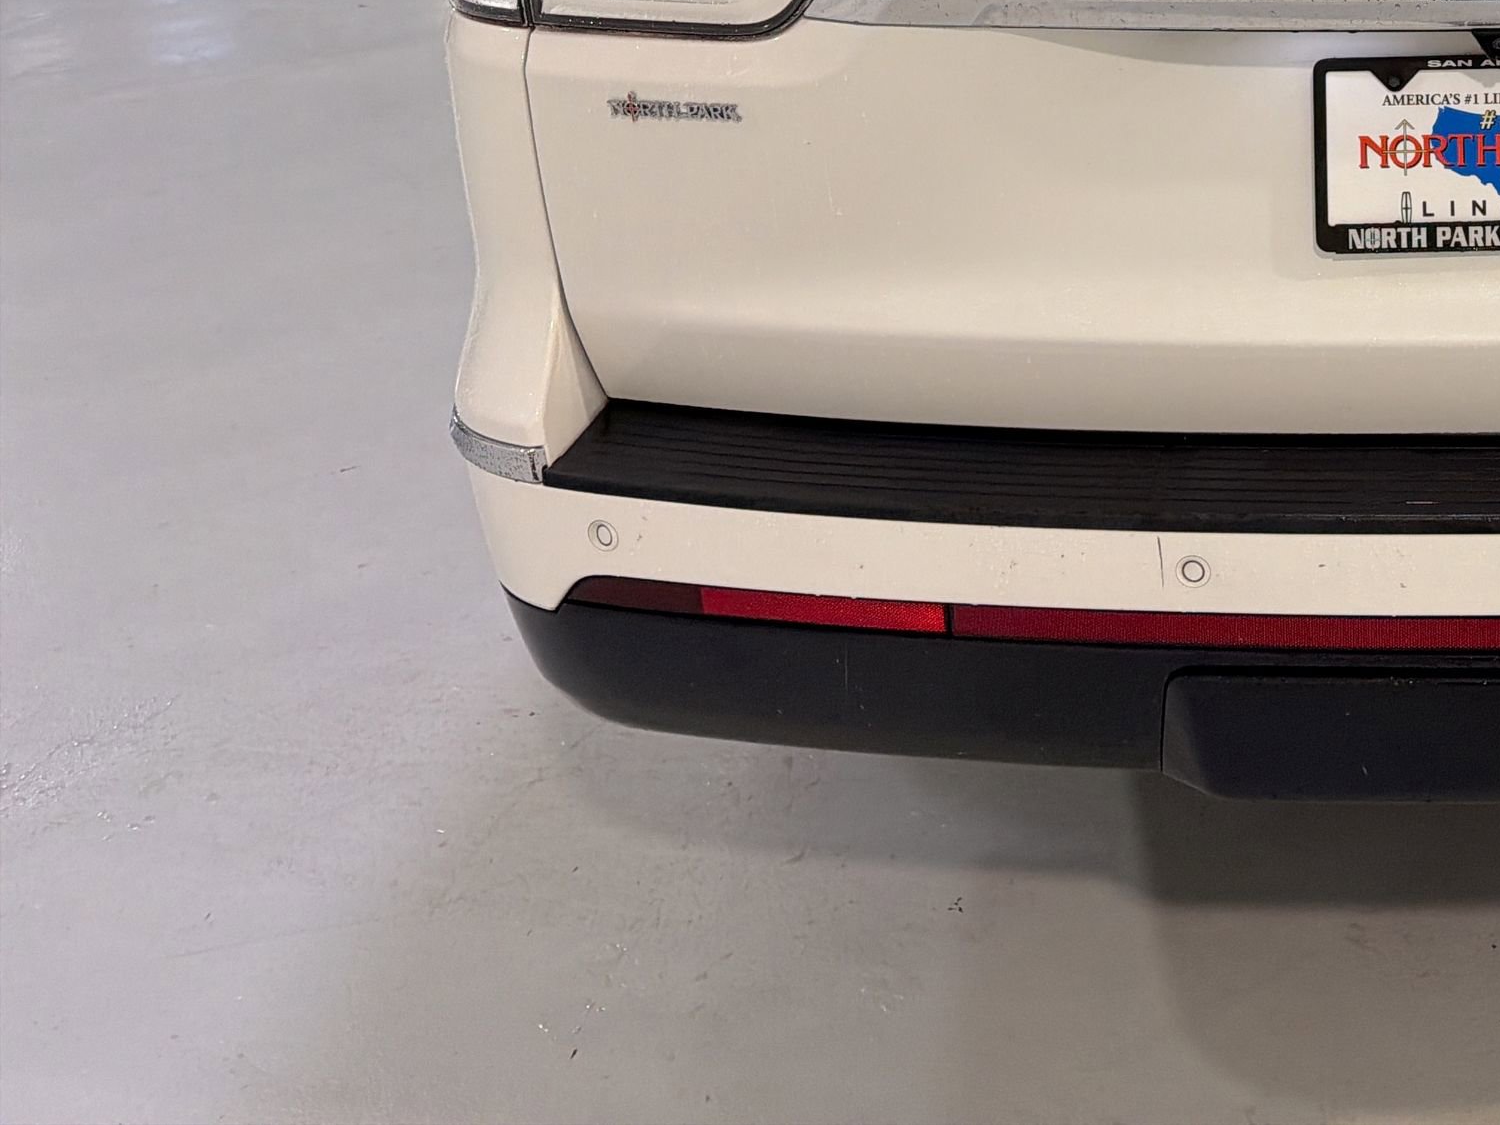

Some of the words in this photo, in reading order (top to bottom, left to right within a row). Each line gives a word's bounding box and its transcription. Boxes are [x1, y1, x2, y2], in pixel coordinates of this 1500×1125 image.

[1427, 59, 1473, 68] SAN
[1383, 93, 1461, 106] AMERICA'S
[1464, 92, 1481, 105] #1
[607, 98, 682, 120] NORTH
[683, 102, 742, 122] PARK
[1348, 225, 1428, 250] NORTH
[1436, 225, 1500, 248] PARK
